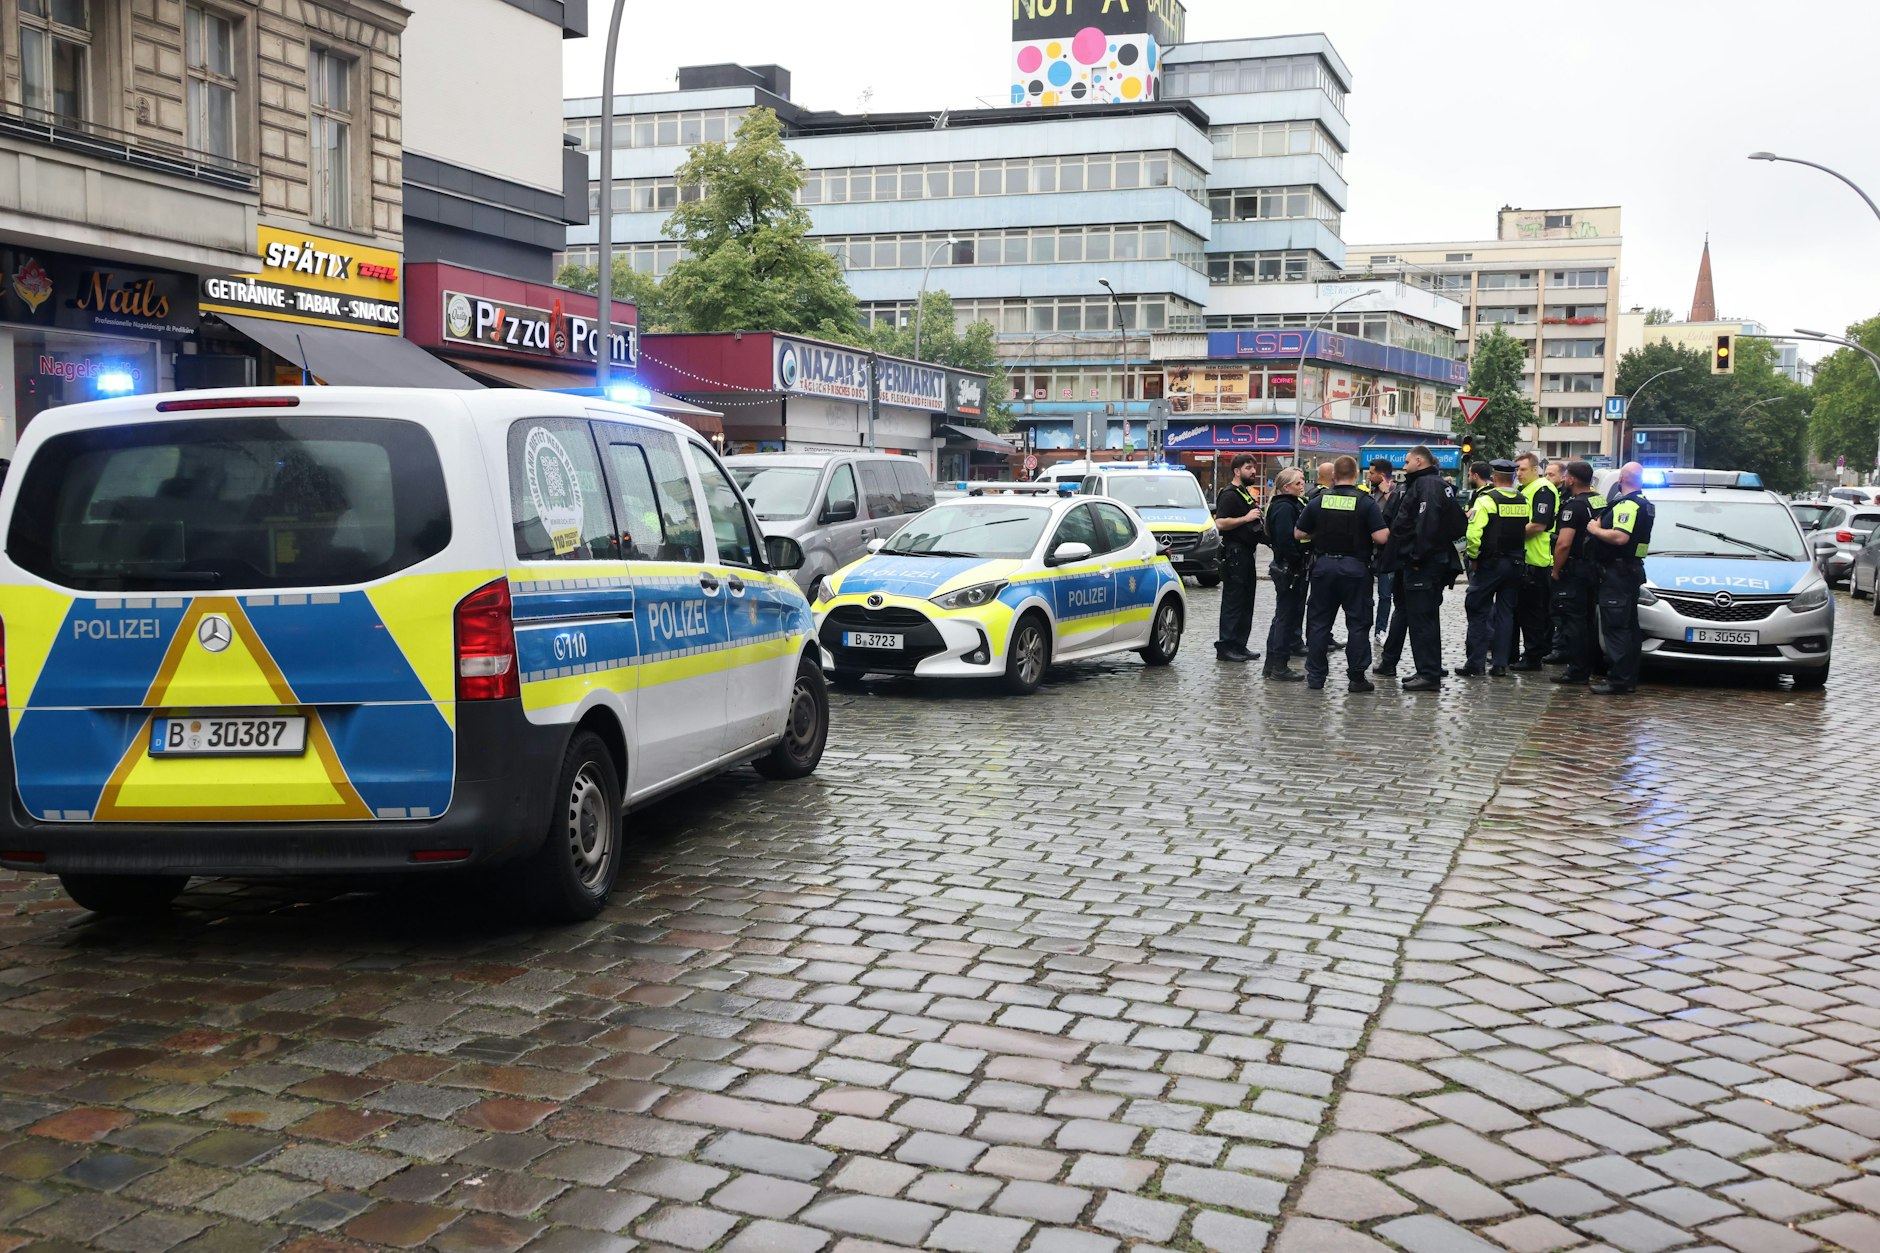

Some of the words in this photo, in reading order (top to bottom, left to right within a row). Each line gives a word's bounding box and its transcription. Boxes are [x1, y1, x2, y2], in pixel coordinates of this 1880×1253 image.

[359, 262, 398, 281] DHL
[77, 271, 169, 319] Nails
[207, 277, 285, 308] GETRÄNKE
[297, 291, 341, 316] TABAK
[350, 300, 399, 324] SNACKS
[94, 317, 132, 327] Professionelle
[133, 321, 165, 332] Nageldesign
[572, 318, 636, 362] Pont
[1237, 333, 1303, 353] LSD
[1321, 334, 1345, 358] LSD
[800, 346, 855, 386] NAZAR
[857, 357, 944, 399] SPERMARKT
[891, 393, 910, 404] FLEISCH
[911, 396, 921, 405] UND
[1608, 399, 1620, 413] U
[1213, 424, 1279, 444] LSD
[1300, 425, 1320, 446] SD
[1636, 432, 1646, 444] U
[1322, 496, 1356, 511] POLIZEI
[1500, 505, 1527, 515] POLIZEI
[553, 534, 565, 550] 110
[860, 569, 940, 579] POLIZEI
[1675, 575, 1770, 590] POLIZEI
[1068, 586, 1107, 608] POLIZEI
[73, 618, 160, 640] POLIZEI
[648, 599, 709, 642] POLIZEI
[564, 632, 587, 659] 110
[855, 633, 862, 646] B
[866, 633, 896, 647] 3723
[1699, 630, 1706, 641] B
[1714, 630, 1751, 643] 30565
[168, 722, 184, 748] B
[207, 721, 287, 748] 30387
